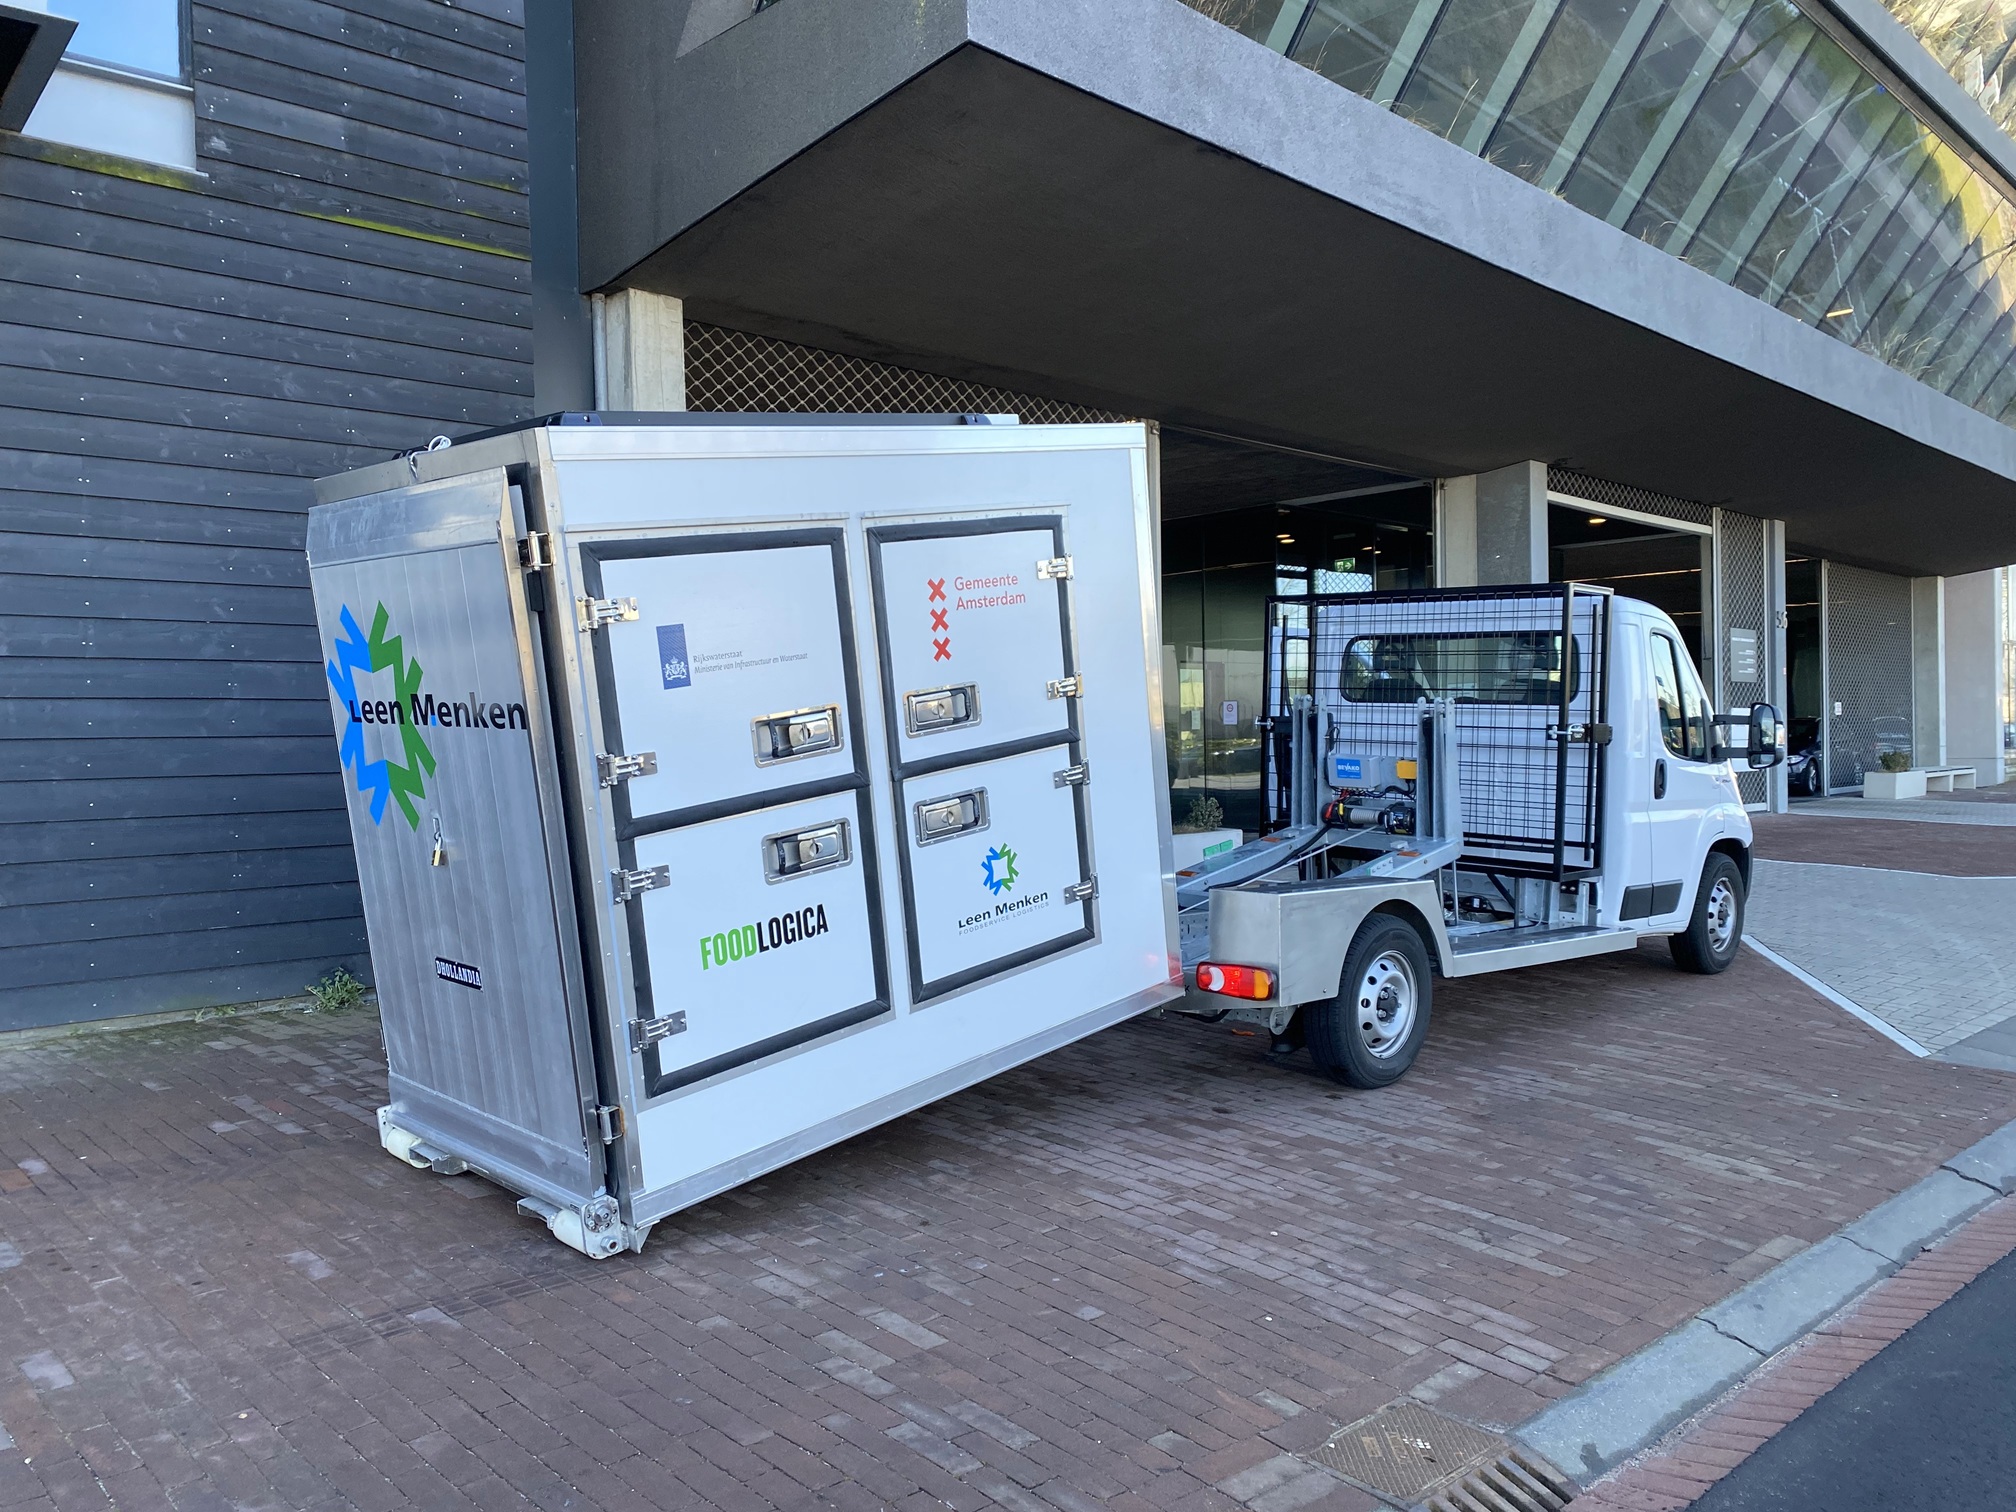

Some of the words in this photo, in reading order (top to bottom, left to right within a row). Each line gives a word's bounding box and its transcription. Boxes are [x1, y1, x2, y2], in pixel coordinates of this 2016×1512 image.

[954, 573, 1018, 591] Gemeente
[956, 590, 1026, 611] Amsterdam
[692, 650, 743, 664] Rijkswaterstaat
[694, 663, 723, 674] Ministerie
[734, 657, 772, 670] Infrastructuur
[779, 652, 808, 663] Waterstaat
[349, 699, 405, 725] Leen
[410, 691, 528, 731] Menken
[957, 910, 991, 929] Leen
[995, 891, 1049, 917] Menken
[958, 914, 1011, 937] FOODSERVICE
[1012, 901, 1050, 919] LOGISTICS
[699, 903, 830, 971] FOODLOGICA
[435, 960, 482, 987] DHOLLANDIA
